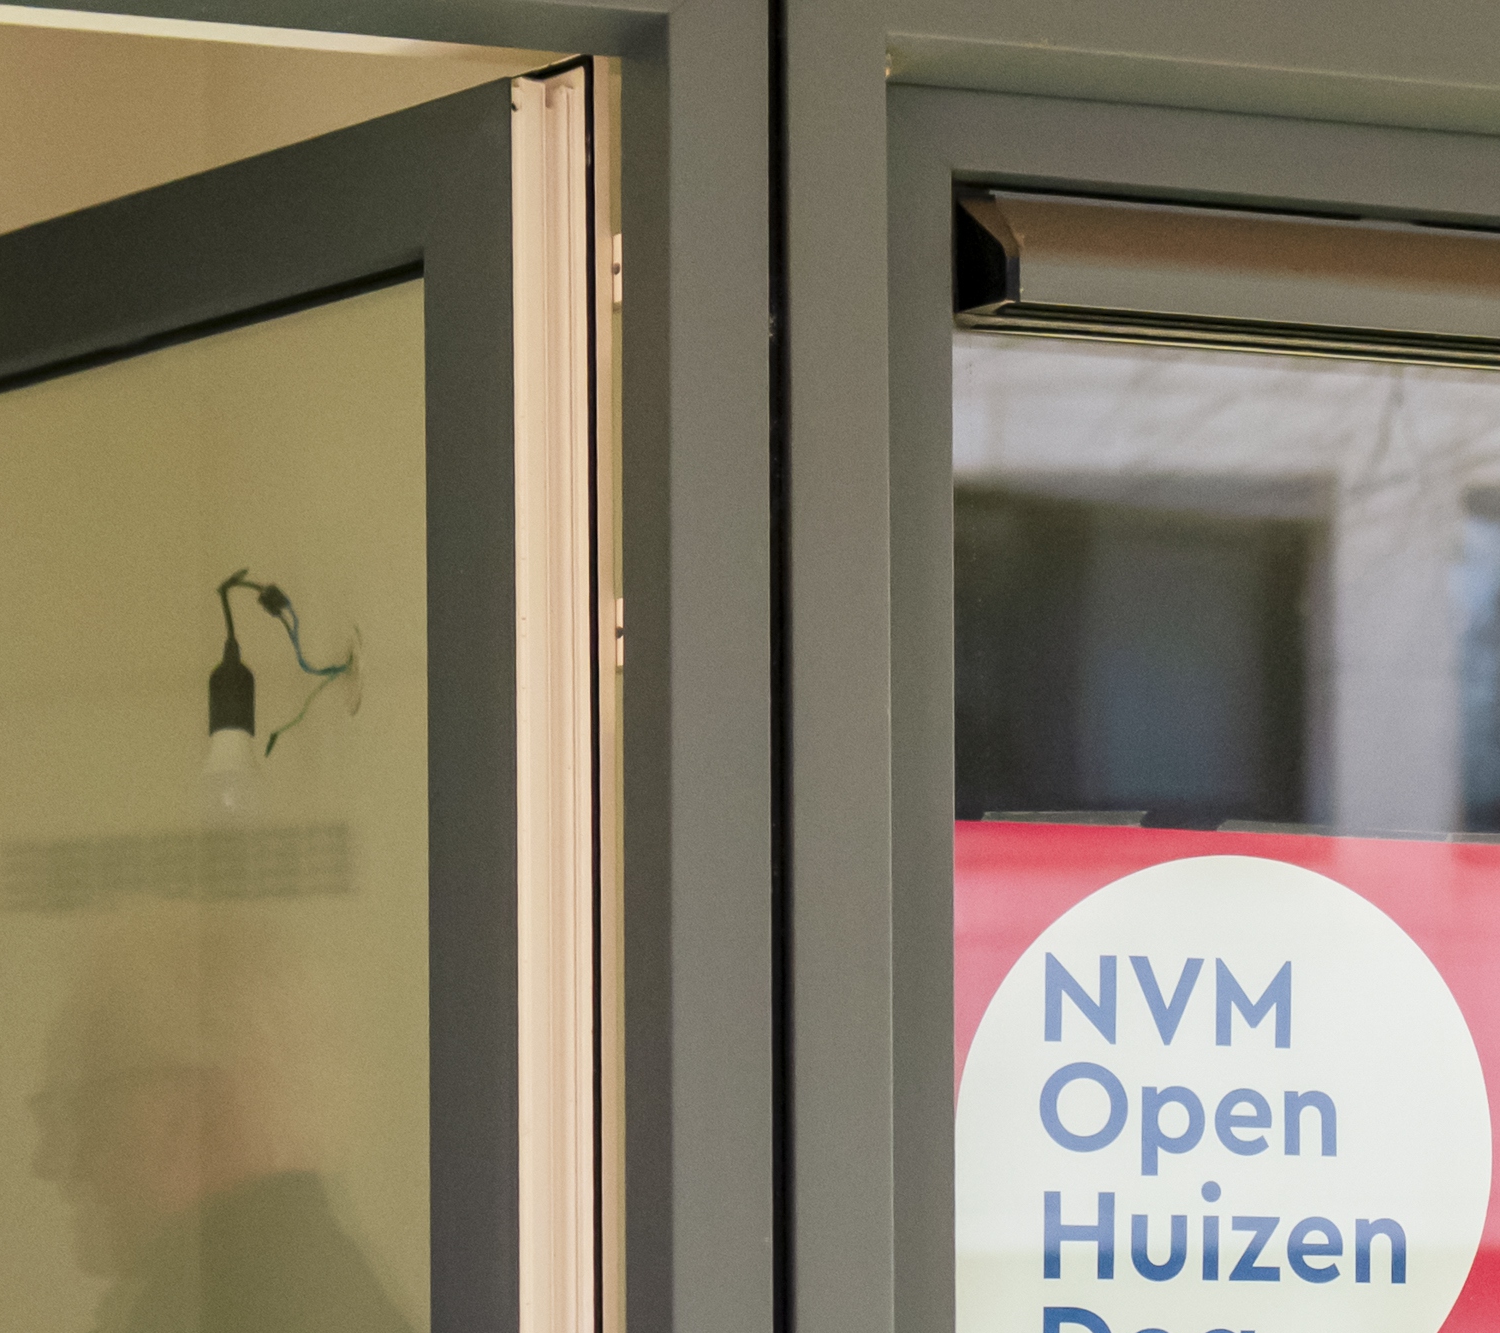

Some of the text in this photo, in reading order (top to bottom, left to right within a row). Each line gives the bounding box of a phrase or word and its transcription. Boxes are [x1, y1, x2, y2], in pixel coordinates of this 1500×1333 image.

[1044, 952, 1292, 1048] NVM
[1039, 1061, 1338, 1177] Open
[1042, 1180, 1407, 1285] Huizen
